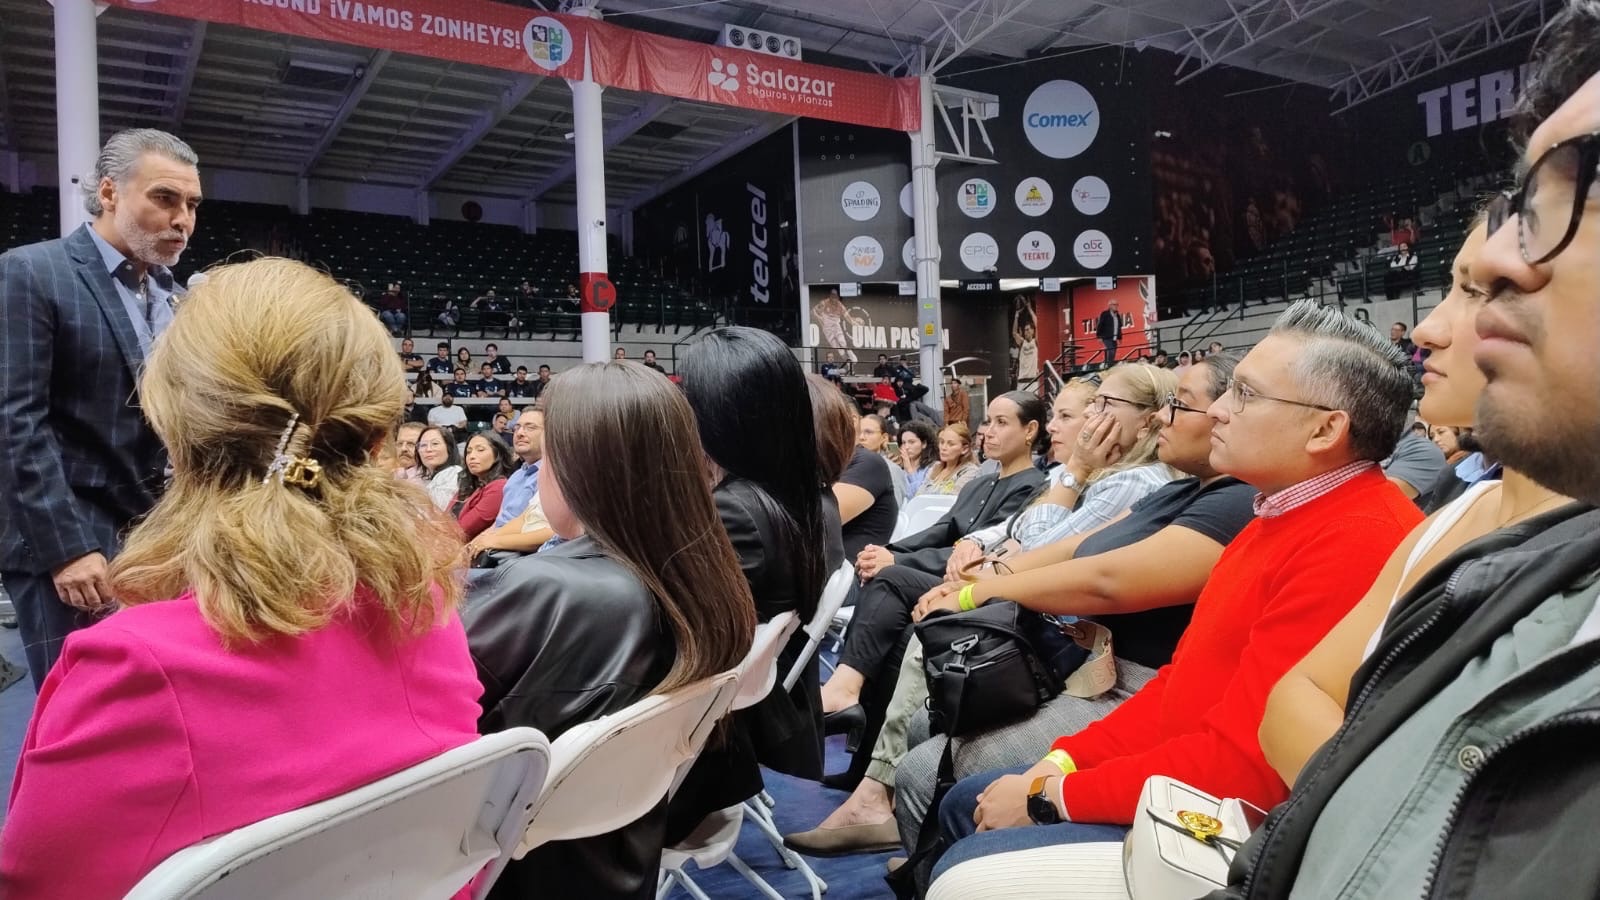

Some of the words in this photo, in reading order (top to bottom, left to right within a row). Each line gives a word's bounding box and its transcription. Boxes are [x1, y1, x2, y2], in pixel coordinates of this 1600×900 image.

[746, 63, 836, 98] Salazar
[746, 85, 788, 100] Seguros
[790, 94, 796, 104] y
[798, 94, 833, 107] Fianzas
[1028, 110, 1094, 128] Comex
[844, 197, 879, 208] SPALDING
[746, 182, 770, 303] telcel
[964, 245, 994, 257] EPIC
[1083, 240, 1104, 250] abc
[1023, 252, 1050, 261] TECATE
[593, 281, 609, 308] C
[852, 325, 888, 349] UNA
